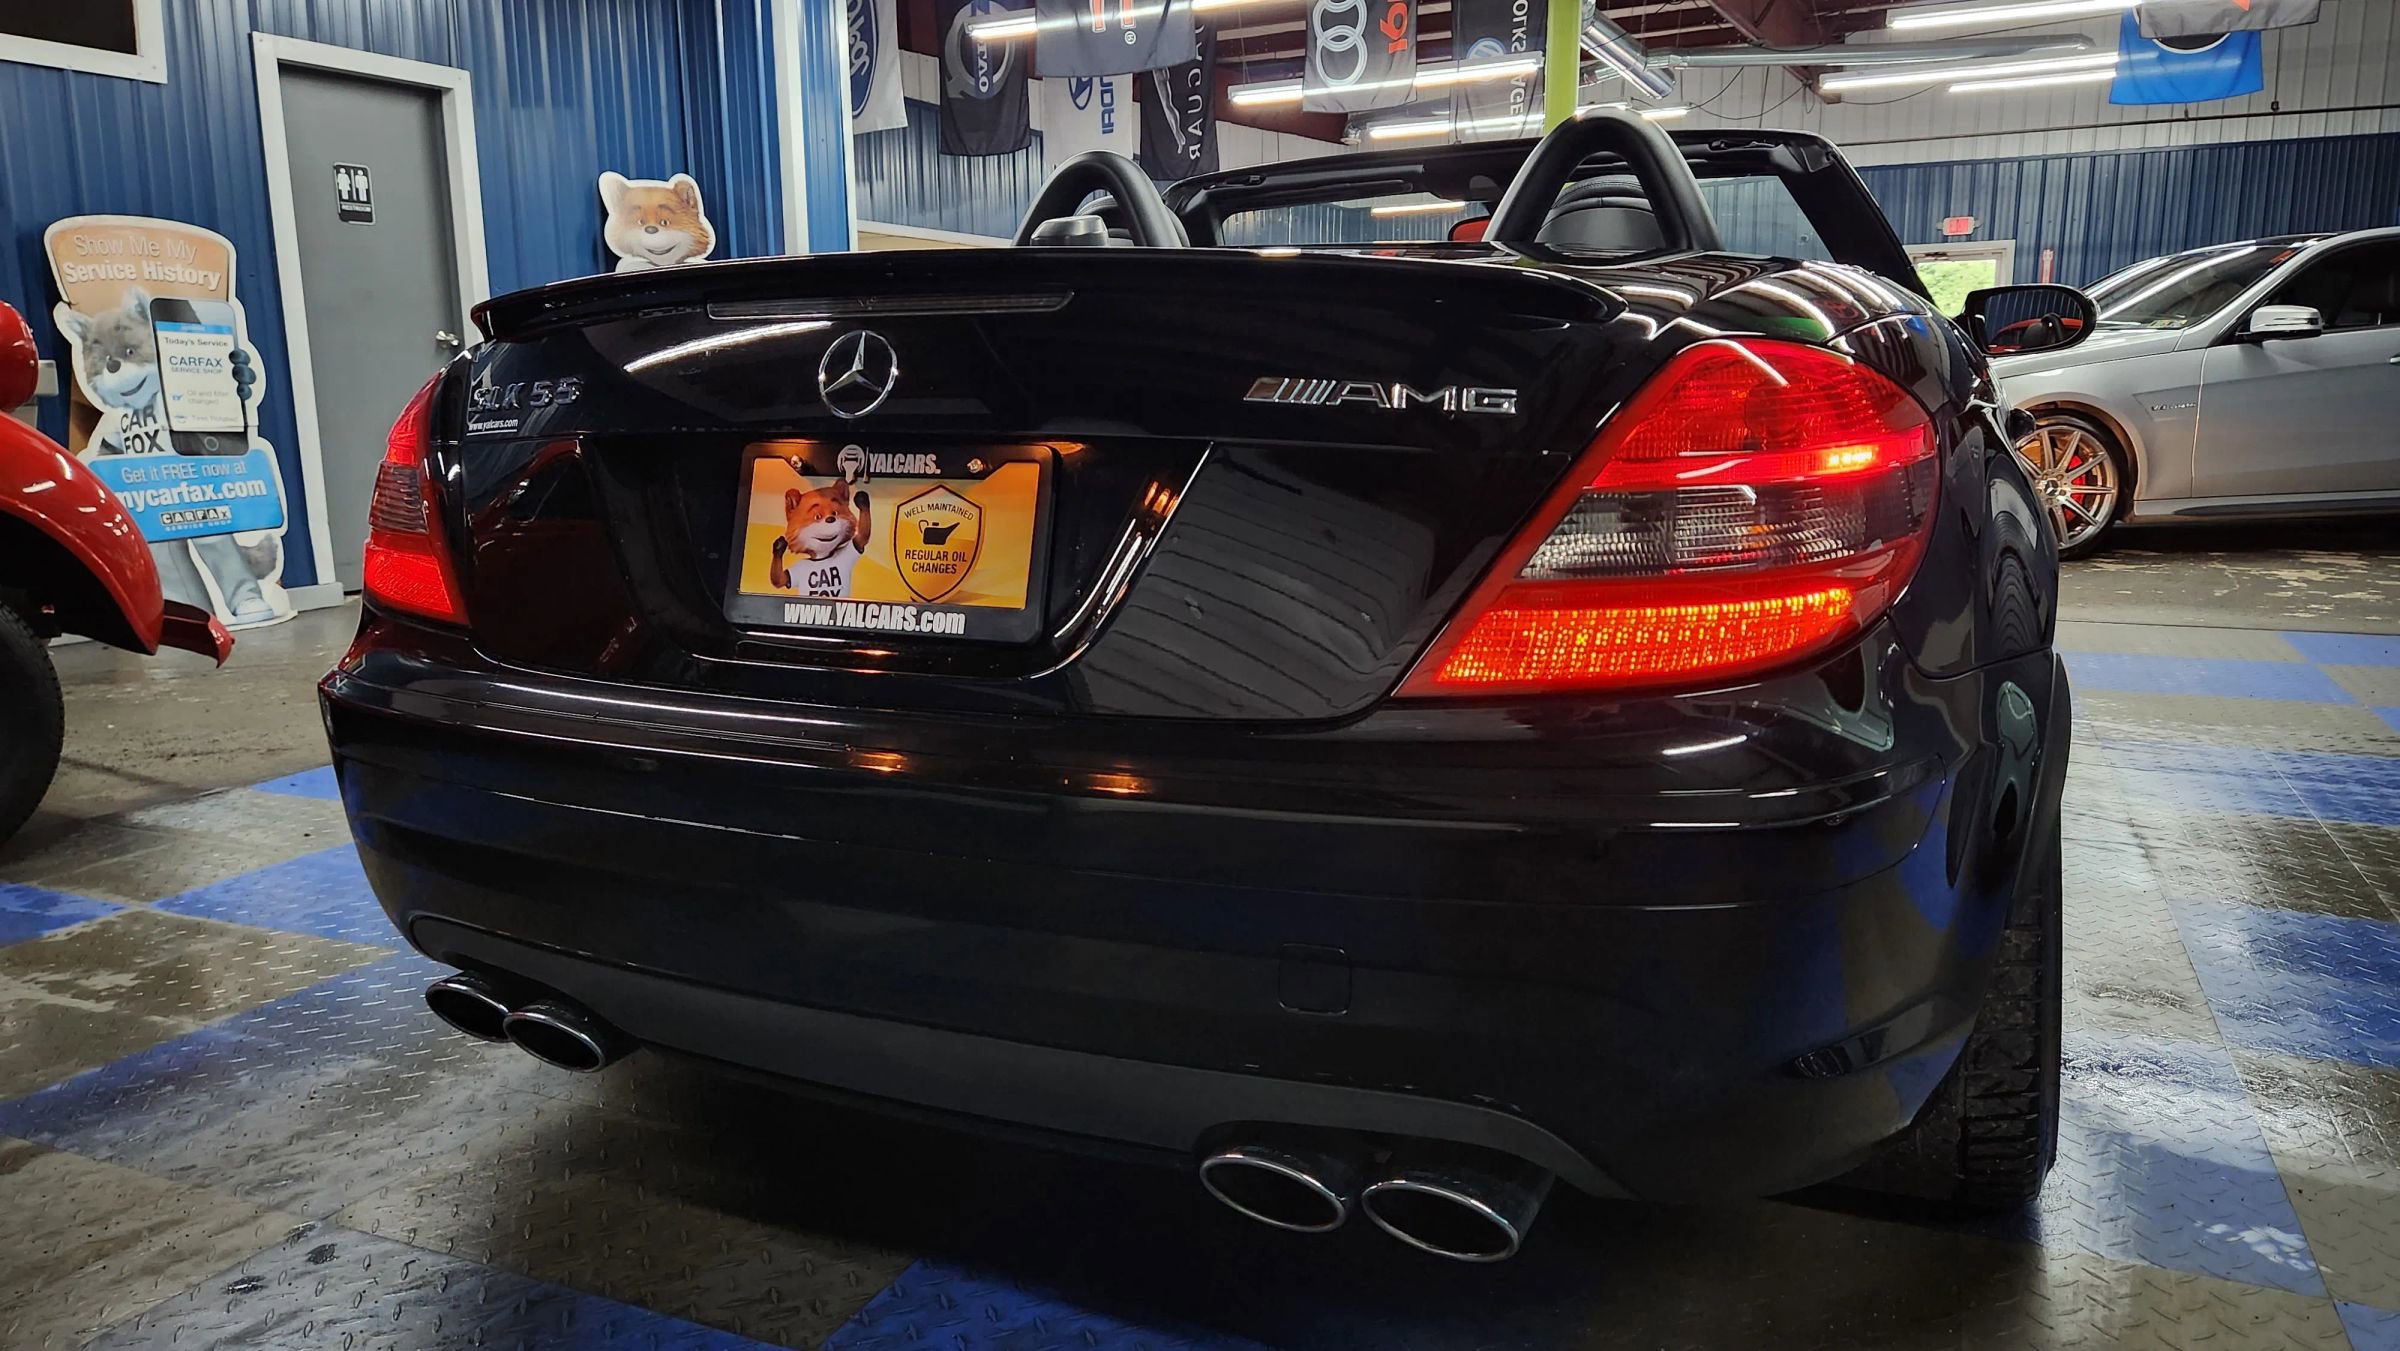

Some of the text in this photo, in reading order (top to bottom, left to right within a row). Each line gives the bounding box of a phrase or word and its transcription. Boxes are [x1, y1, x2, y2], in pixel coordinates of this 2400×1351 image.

[74, 234, 198, 266] Show Me My
[63, 260, 222, 291] Service History
[165, 337, 229, 347] Today's Service
[169, 355, 223, 368] CARFAX
[473, 377, 584, 411] SLK 55
[1326, 380, 1518, 414] AMG
[120, 403, 158, 434] CAR
[468, 418, 519, 432] www.yalcars.com
[123, 428, 165, 454] FOX
[121, 460, 248, 484] Get it FREE now at
[869, 453, 941, 474] YALCARS.
[115, 479, 268, 513] mycarfax.com
[161, 506, 232, 525] CARFAX
[904, 503, 974, 521] WELL MAINTAINED
[905, 549, 967, 562] REGULAR OIL
[808, 566, 842, 589] CAR
[912, 562, 957, 574] CHANGES
[784, 602, 966, 635] www.YALCARS.com
